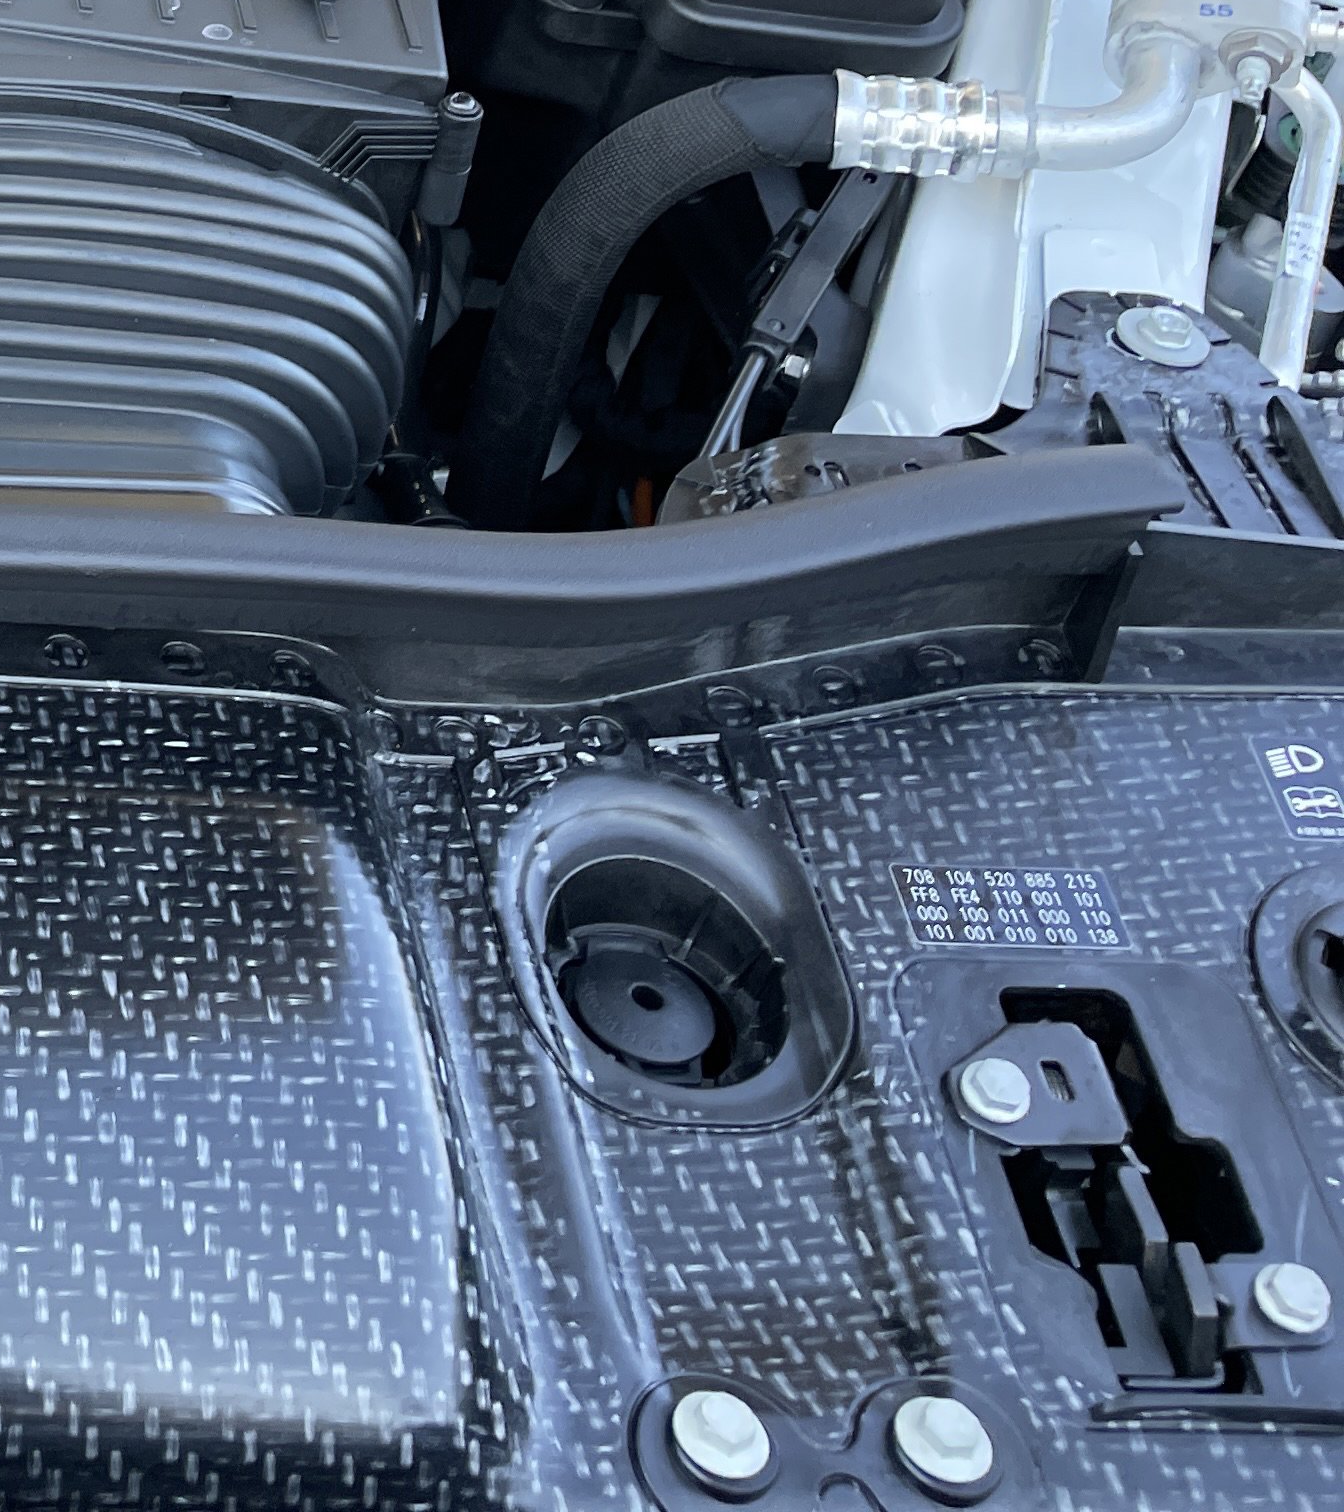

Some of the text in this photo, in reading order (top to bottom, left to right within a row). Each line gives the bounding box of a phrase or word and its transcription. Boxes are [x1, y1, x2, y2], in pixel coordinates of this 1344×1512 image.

[902, 868, 1096, 889] 708 104 520 885 215
[910, 886, 1103, 908] FF8 FE4 110 001 101
[916, 905, 1112, 926] 000 100 011 000 110
[925, 924, 1119, 945] 101 001 010 010 138
